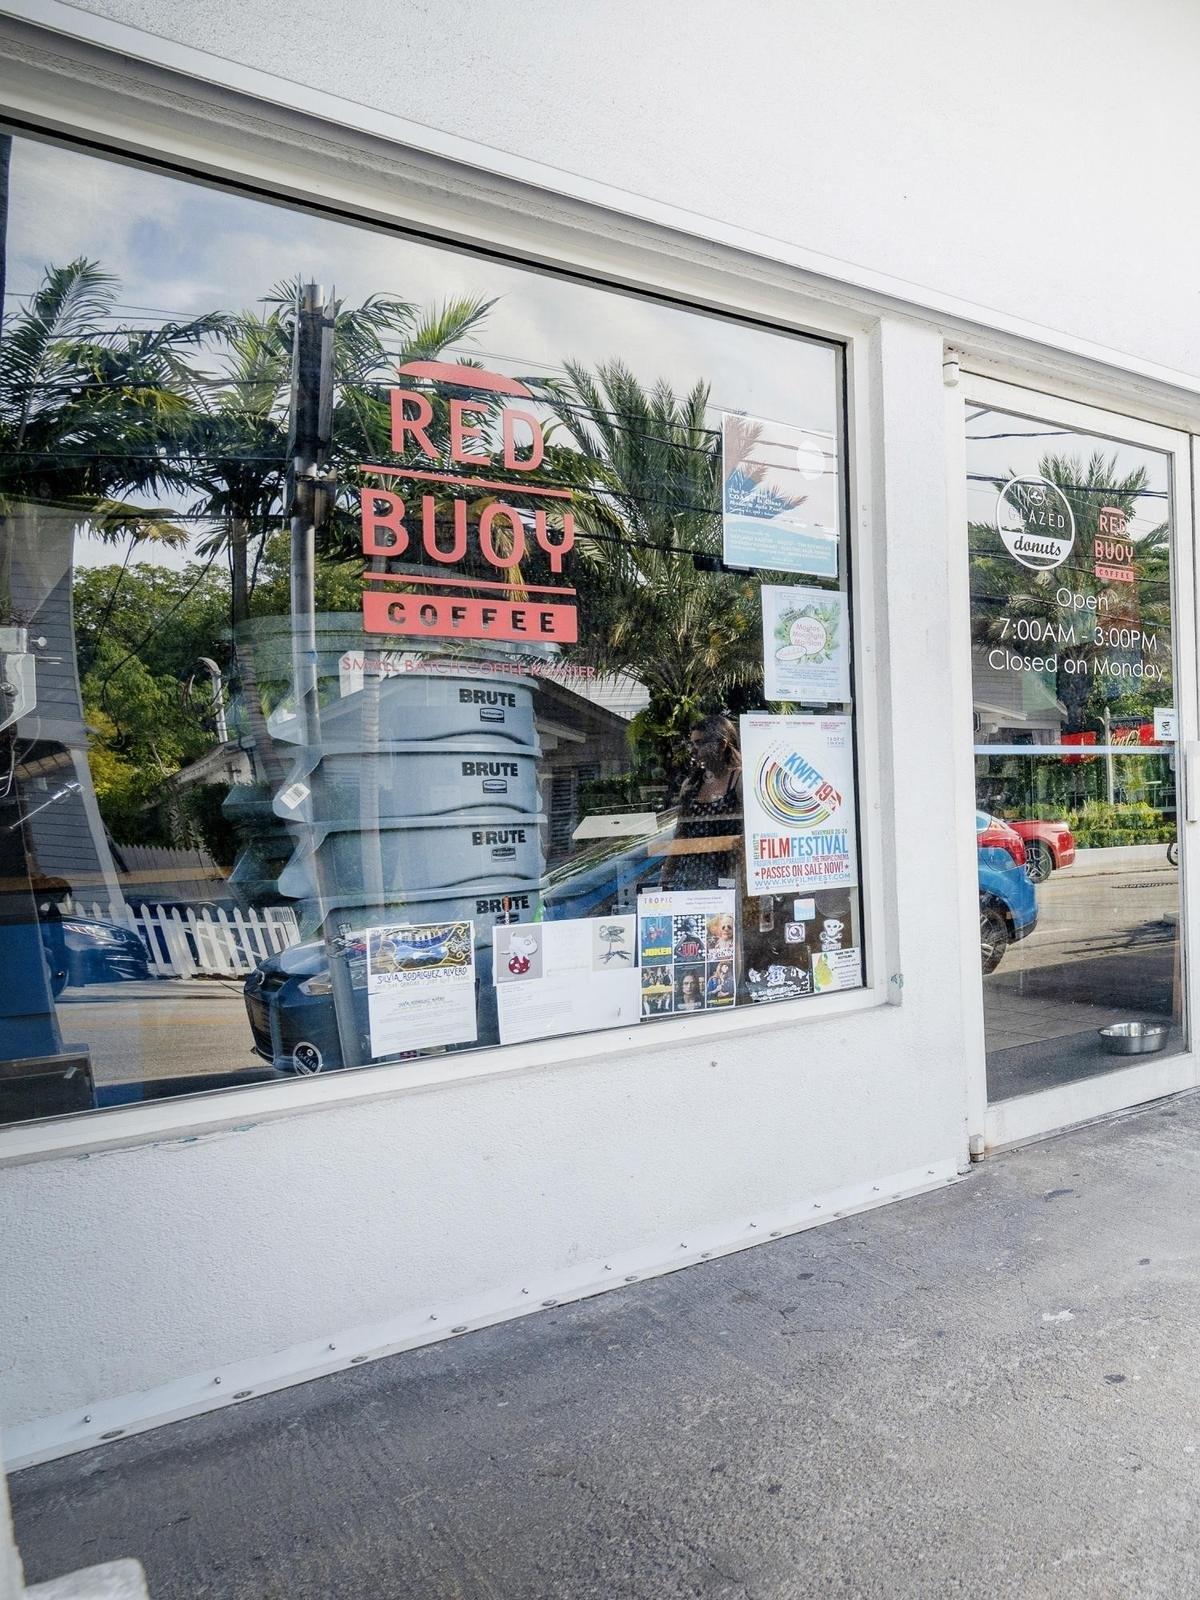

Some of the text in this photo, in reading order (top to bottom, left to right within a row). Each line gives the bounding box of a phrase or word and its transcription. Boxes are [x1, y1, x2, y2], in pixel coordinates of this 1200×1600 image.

[390, 389, 543, 471] RED
[361, 488, 574, 572] BUOY
[1100, 514, 1127, 534] RED
[1014, 536, 1061, 556] donuts
[1095, 540, 1134, 562] BUOY
[1099, 569, 1130, 580] COFFEE
[1056, 588, 1108, 611] Open
[387, 602, 555, 633] COFFEE
[999, 618, 1075, 645] 7:00AM
[1094, 627, 1158, 650] 3:00PM
[404, 659, 460, 674] BATCH
[466, 662, 525, 676] COFFEE
[989, 650, 1163, 682] Closed on Monday
[459, 688, 516, 707] BRUTE
[462, 762, 518, 777] BRUTE
[472, 829, 526, 846] BRUTE
[761, 864, 791, 880] PASSES
[792, 863, 804, 877] ON
[805, 862, 823, 876] SALE
[824, 861, 844, 873] NOW!
[377, 973, 402, 985] SILVIA
